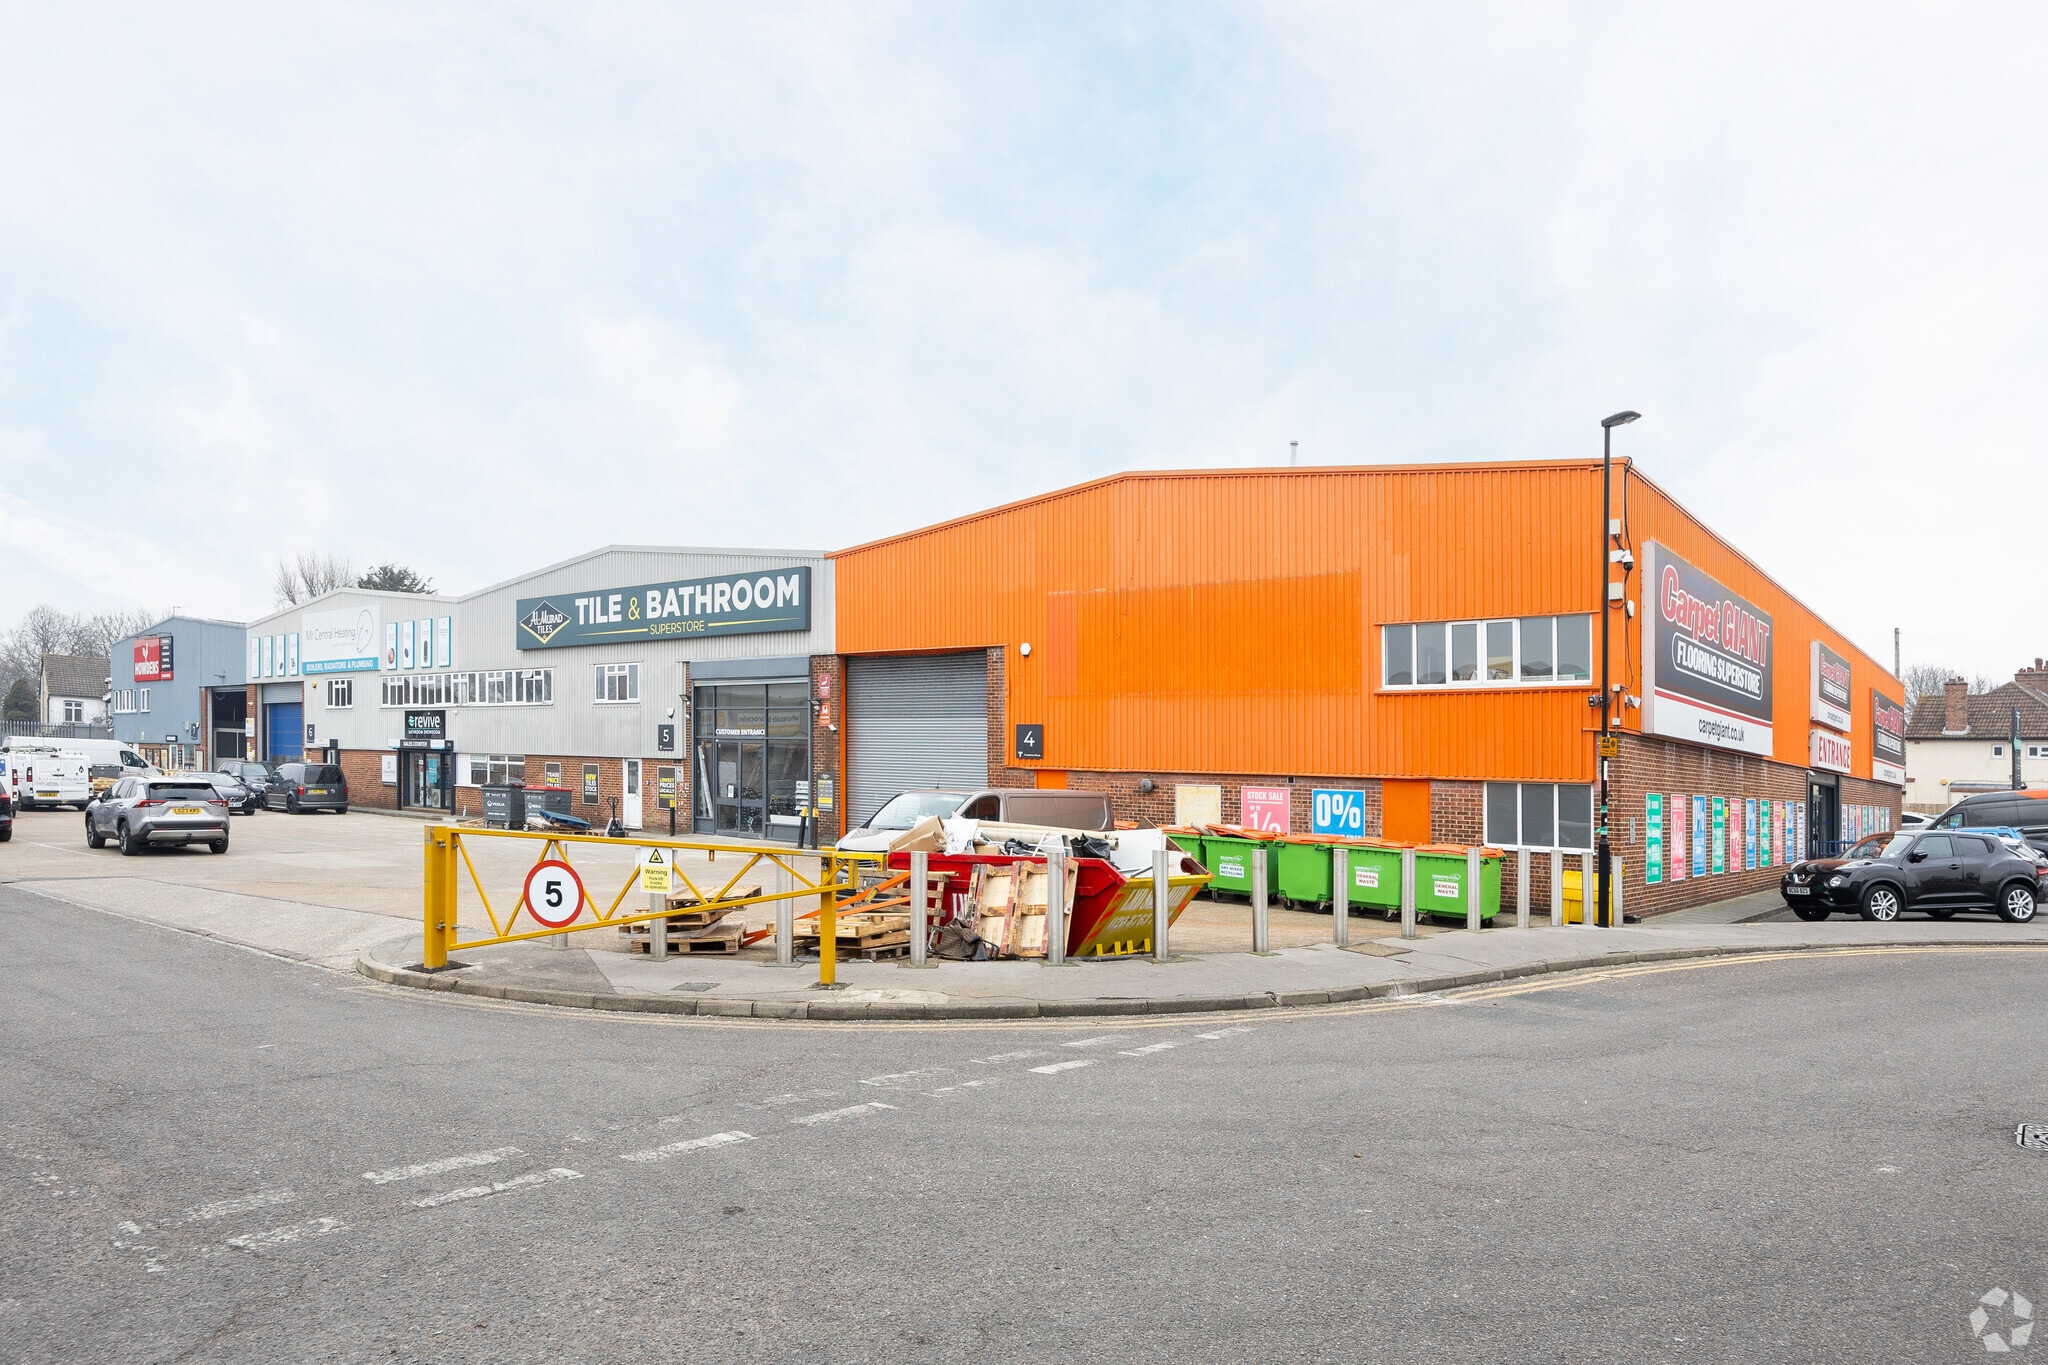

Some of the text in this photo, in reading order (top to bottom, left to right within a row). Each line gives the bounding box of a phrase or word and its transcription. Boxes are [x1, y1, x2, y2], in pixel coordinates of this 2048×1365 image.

[575, 574, 800, 625] TILE & BATHROOM
[1661, 564, 1770, 668] Carpet GIANT
[306, 626, 356, 641] Mr Central Heating
[537, 625, 553, 634] TILES
[650, 620, 705, 635] SUPERSTORE
[135, 660, 159, 675] HOWDENS
[324, 661, 346, 670] RADIATORS
[351, 659, 374, 669] PLUMBING
[1677, 640, 1760, 695] FLOORING SUPERSTORE
[414, 712, 440, 728] revive
[308, 727, 313, 737] 6
[663, 729, 669, 742] 5
[715, 728, 740, 736] CUSTOMER
[1698, 718, 1745, 742] carpetgiant.co.uk
[1023, 730, 1035, 747] 4
[1818, 736, 1850, 769] ENTRANCE
[1248, 791, 1284, 801] STOCK SALE
[1316, 793, 1361, 829] 0%
[645, 868, 668, 876] Warning
[545, 880, 563, 907] 5
